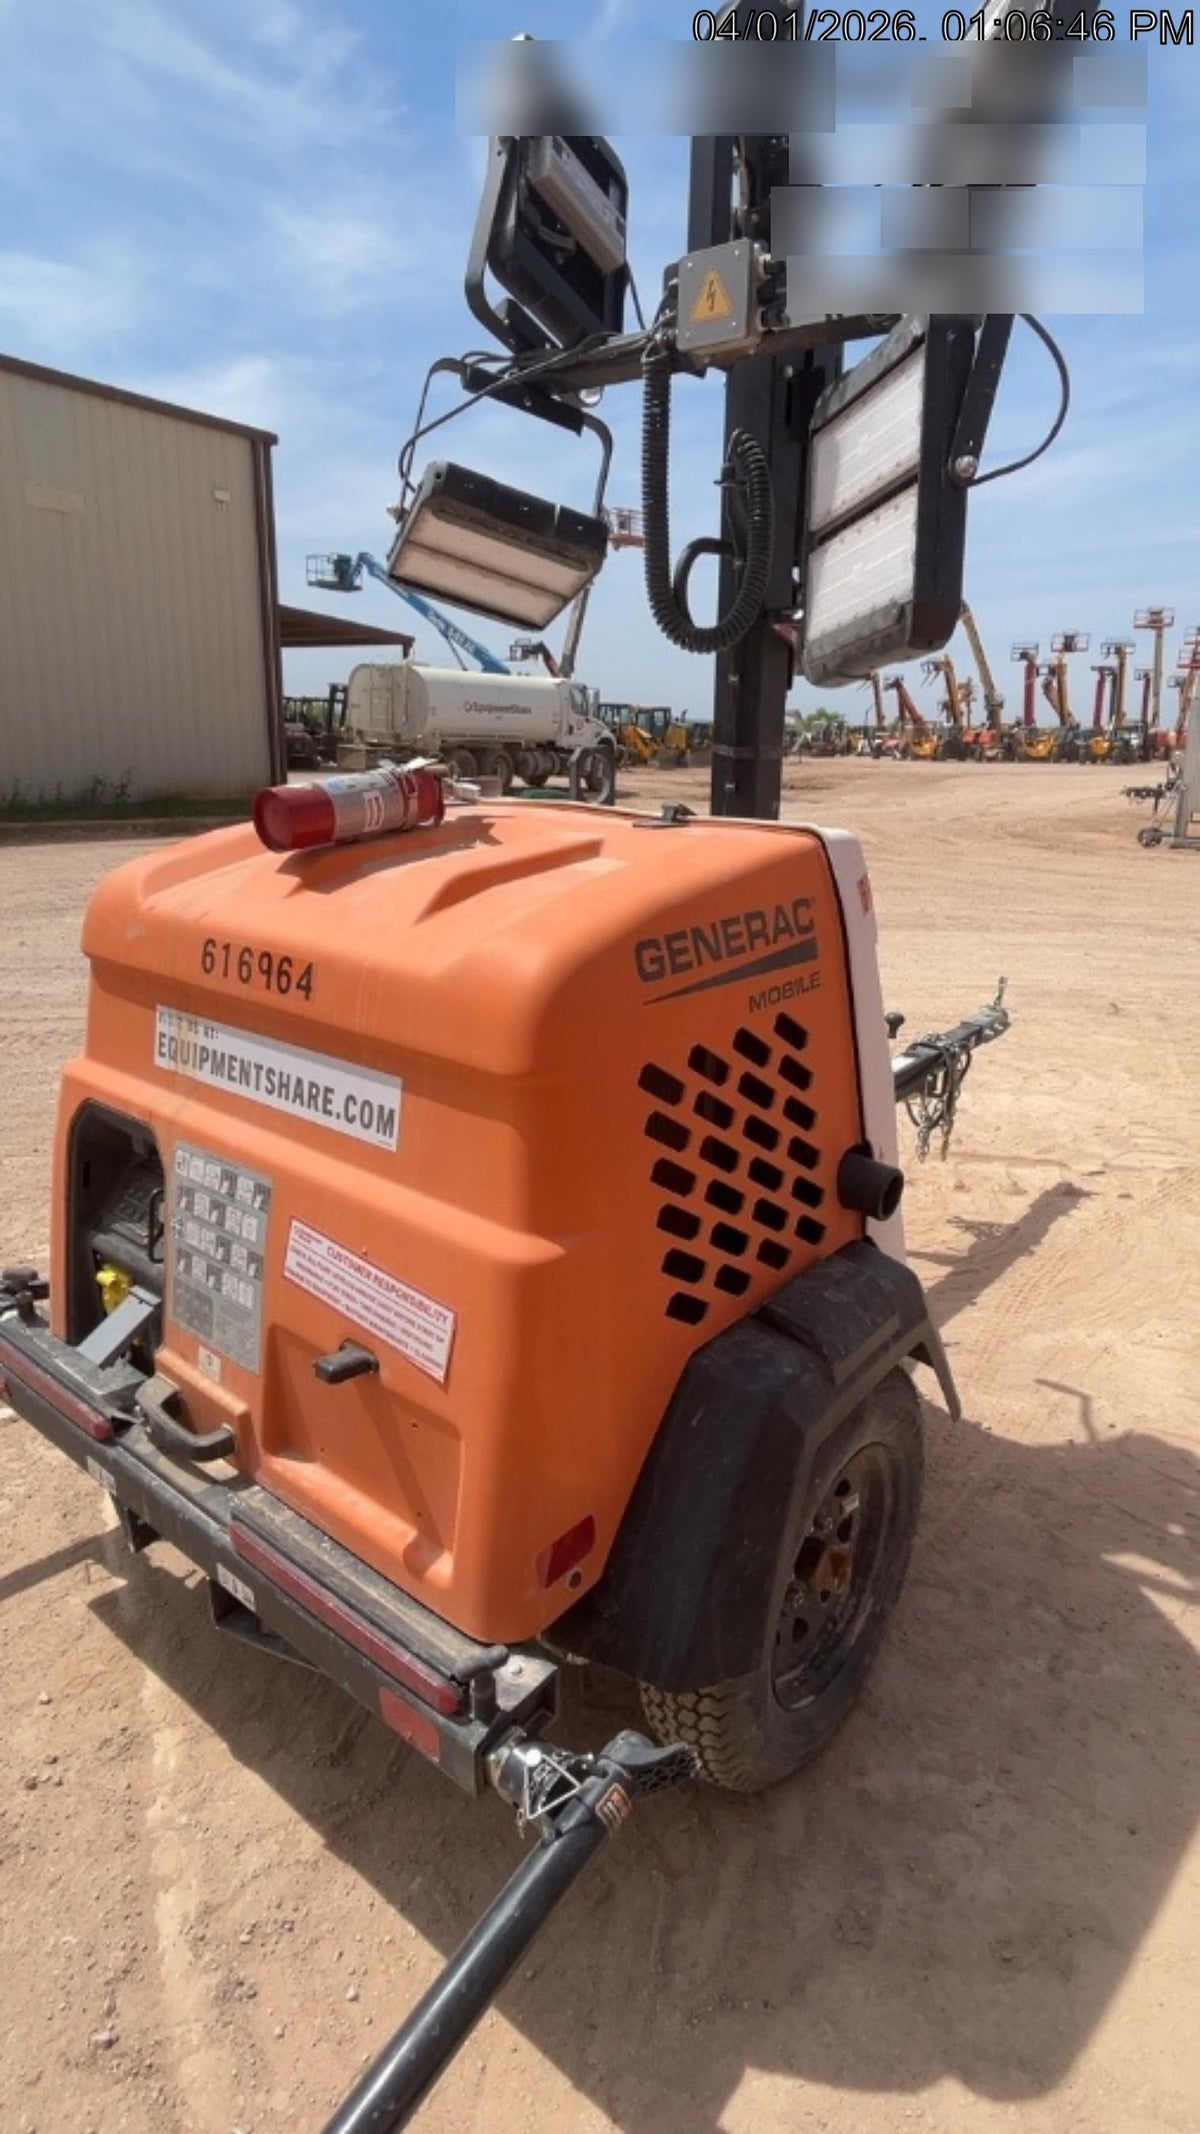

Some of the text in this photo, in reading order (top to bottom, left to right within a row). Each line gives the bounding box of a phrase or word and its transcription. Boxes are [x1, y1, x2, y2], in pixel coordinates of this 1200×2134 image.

[202, 938, 314, 1001] 616964
[634, 898, 815, 983] GENERAC
[748, 971, 822, 1013] MOBILE
[158, 1031, 396, 1139] EQUIPMENTSHARE.COM
